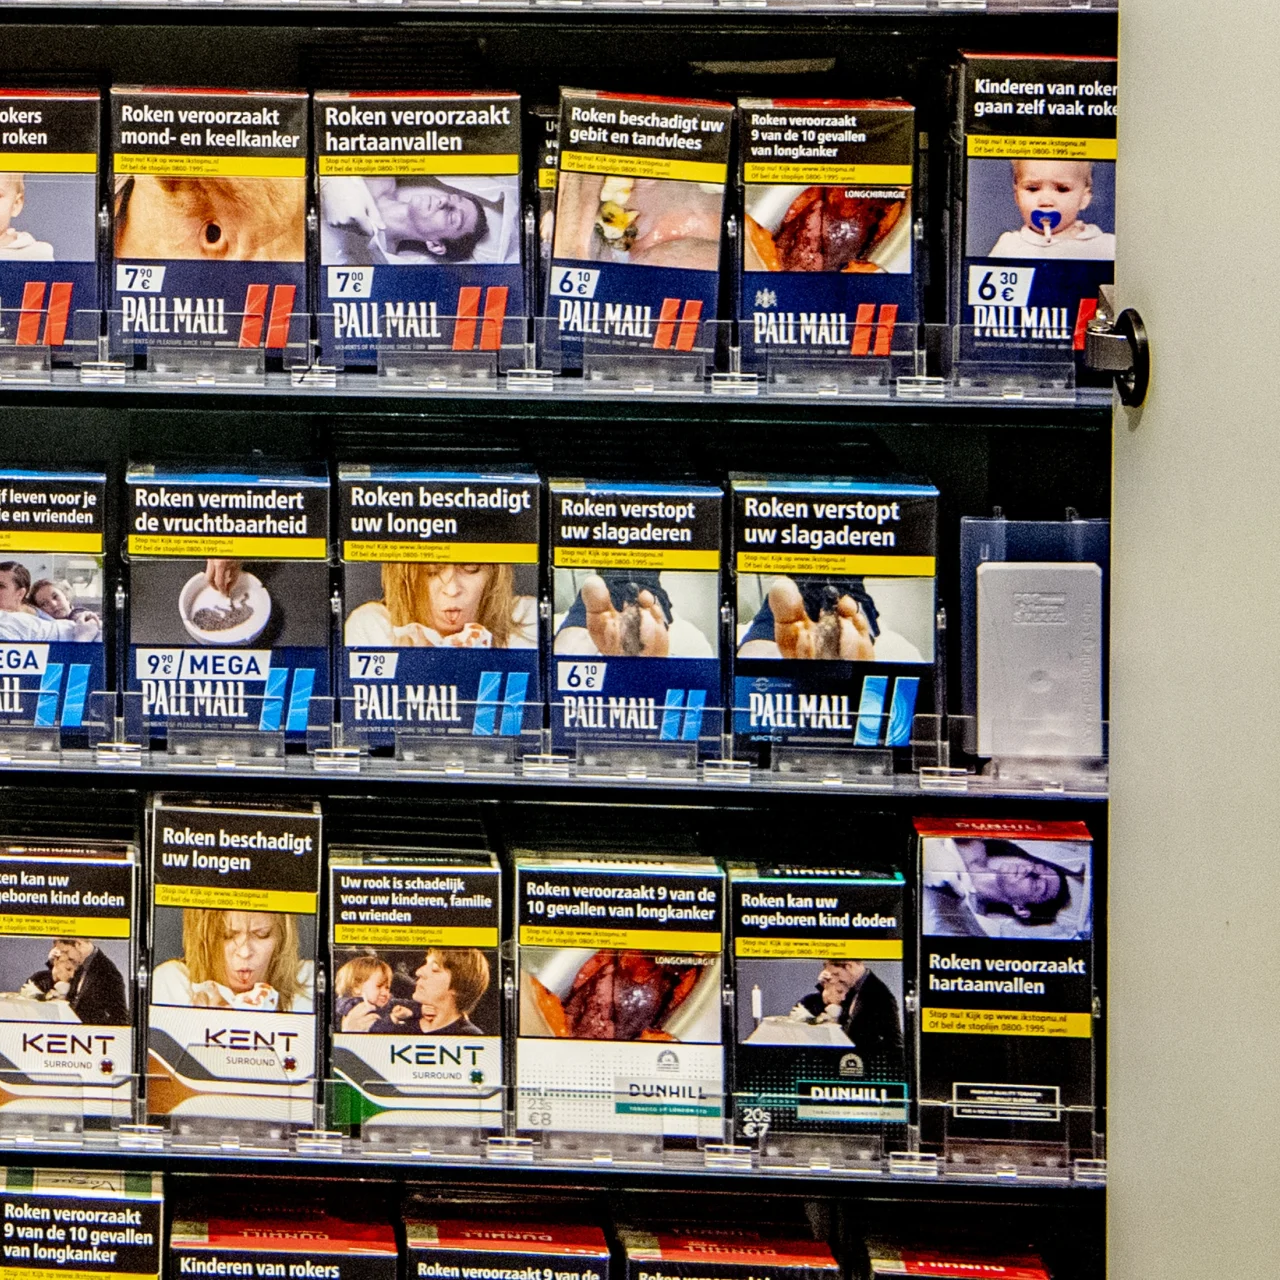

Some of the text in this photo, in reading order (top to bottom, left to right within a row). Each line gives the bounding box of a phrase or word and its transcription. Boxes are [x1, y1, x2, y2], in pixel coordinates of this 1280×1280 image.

[122, 296, 228, 335] PALL MALL
[10, 489, 46, 504] leven
[50, 494, 78, 504] voor
[81, 491, 96, 508] je
[13, 511, 30, 522] en
[33, 509, 93, 524] vrienden
[750, 734, 783, 743] ARCTIC
[930, 954, 1085, 974] Roken veroorzaakt
[930, 974, 1044, 994] hartaanvallen
[929, 1009, 1067, 1024] Stop nu! Kijk op www.ikstopnu.nl
[390, 1043, 485, 1067] KENT
[629, 1082, 707, 1101] DUNHILL
[742, 1108, 772, 1124] 20s
[181, 1257, 340, 1278] Kinderen van rokers
